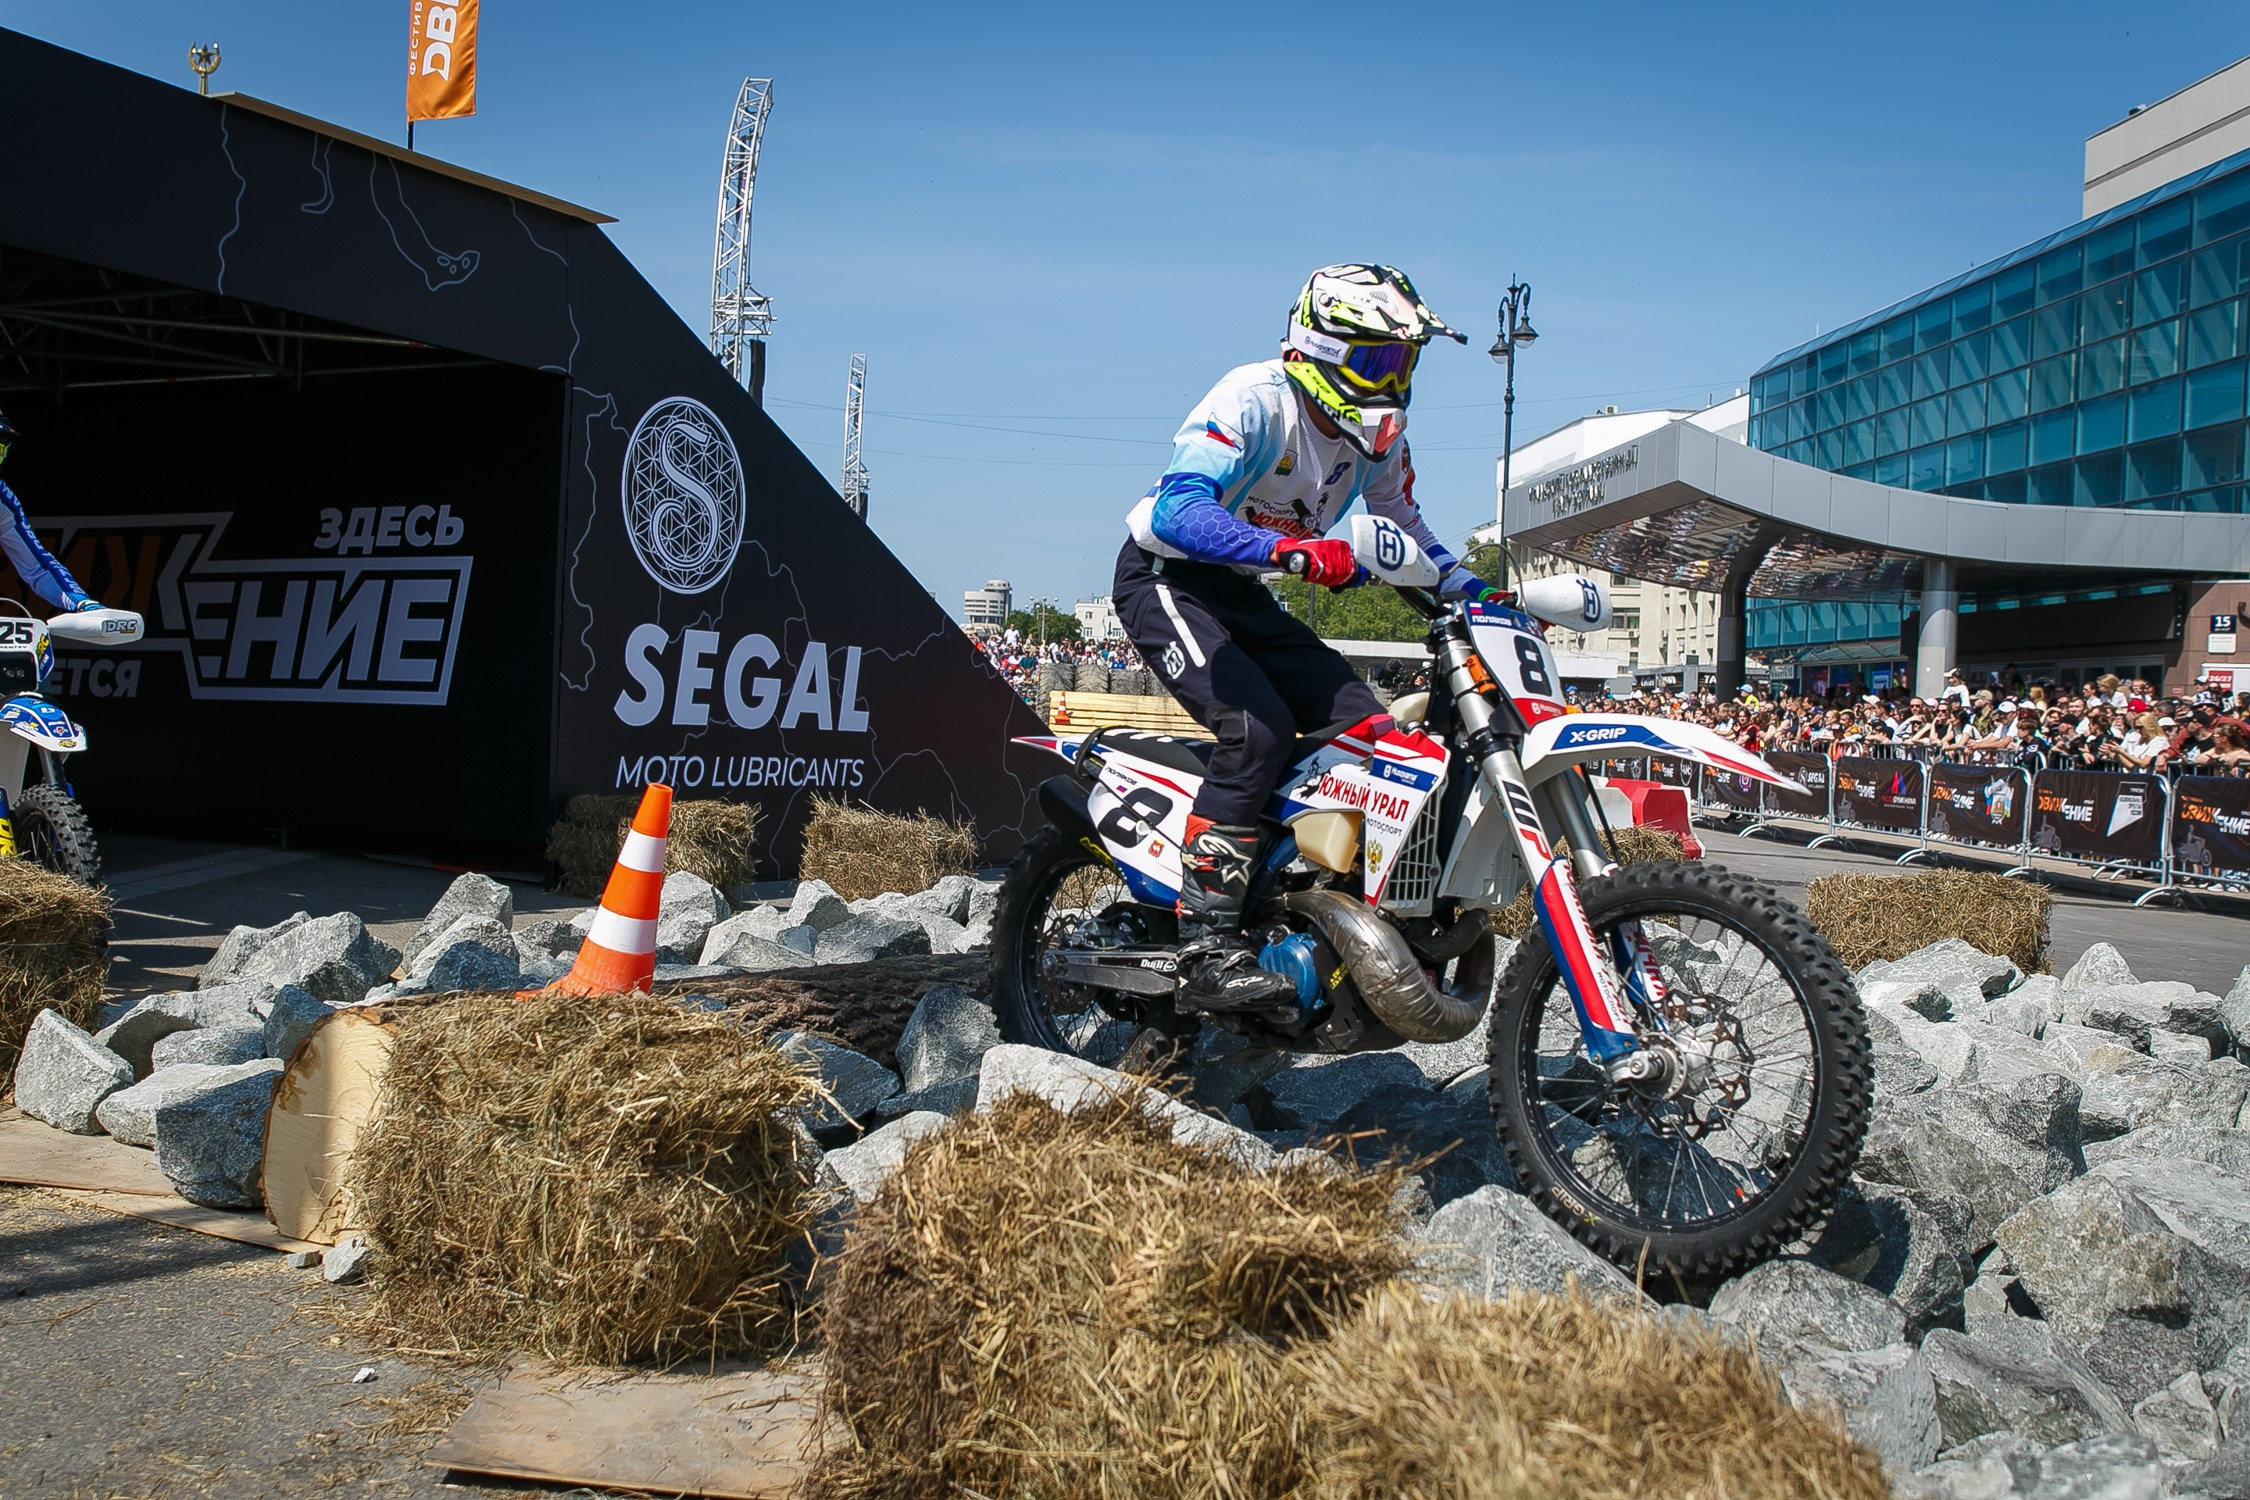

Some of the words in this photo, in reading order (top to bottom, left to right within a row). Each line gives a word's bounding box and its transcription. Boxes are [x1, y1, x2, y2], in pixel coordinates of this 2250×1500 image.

[1324, 461, 1352, 486] 8
[1247, 495, 1296, 517] МОТОСПОРТ
[313, 504, 465, 555] ЗДЕСЬ
[2215, 615, 2232, 628] 15
[50, 657, 142, 698] ЕТСЯ
[613, 623, 870, 733] SEGAL
[1514, 634, 1553, 697] 8
[1569, 727, 1627, 744] X-GRIP
[615, 755, 705, 789] MOTO
[712, 756, 865, 789] LUBRICANTS
[1097, 786, 1174, 849] 8
[1318, 773, 1372, 811] ЮЖНЫЙ
[1370, 790, 1411, 823] УРАЛ
